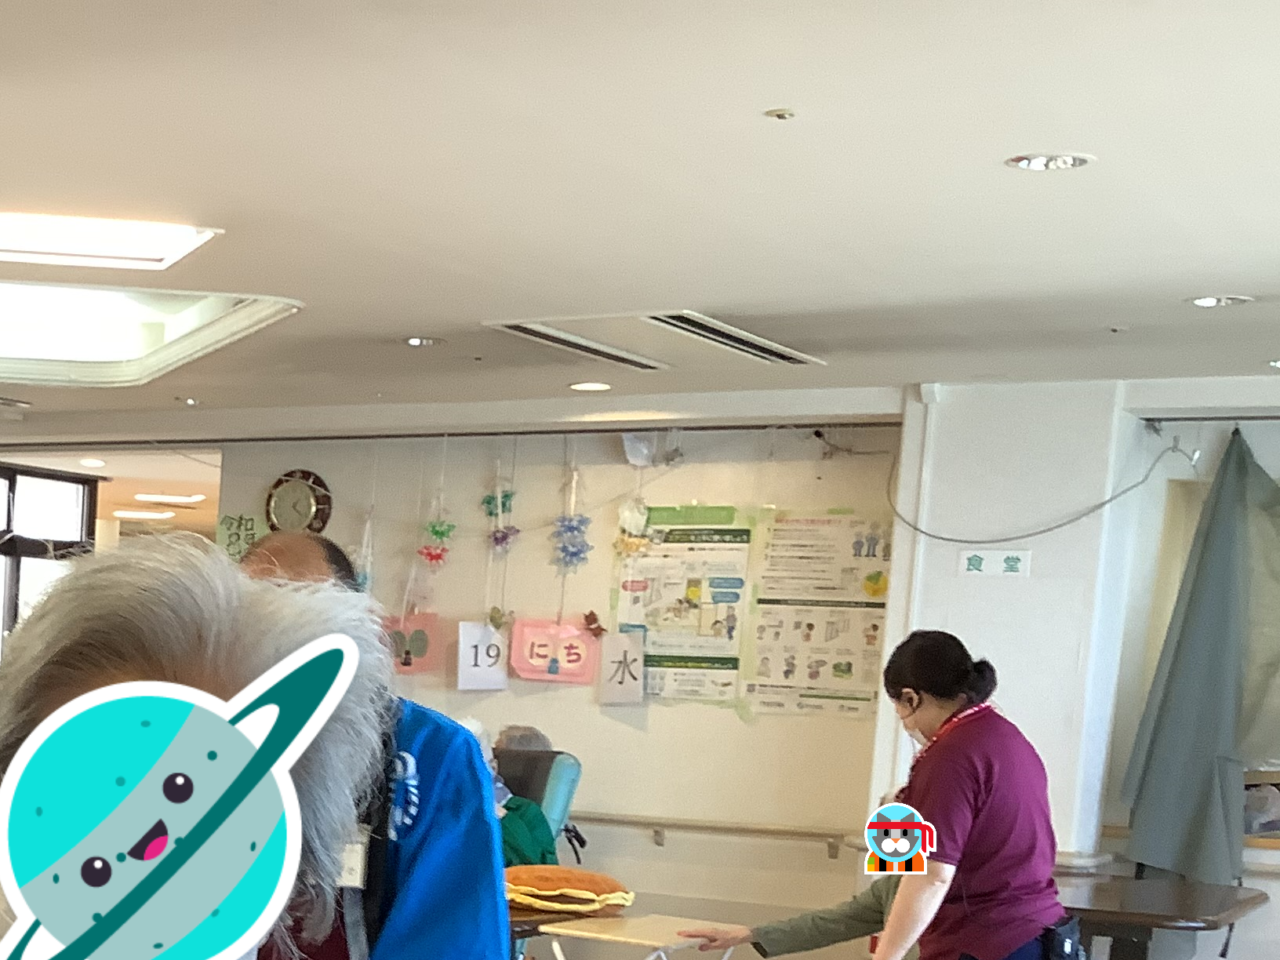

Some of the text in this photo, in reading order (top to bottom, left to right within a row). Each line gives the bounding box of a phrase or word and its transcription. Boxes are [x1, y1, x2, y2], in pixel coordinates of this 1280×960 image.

[966, 554, 1022, 573] 食堂
[471, 643, 501, 668] 19
[529, 641, 582, 664] にち
[608, 649, 638, 685] 水
